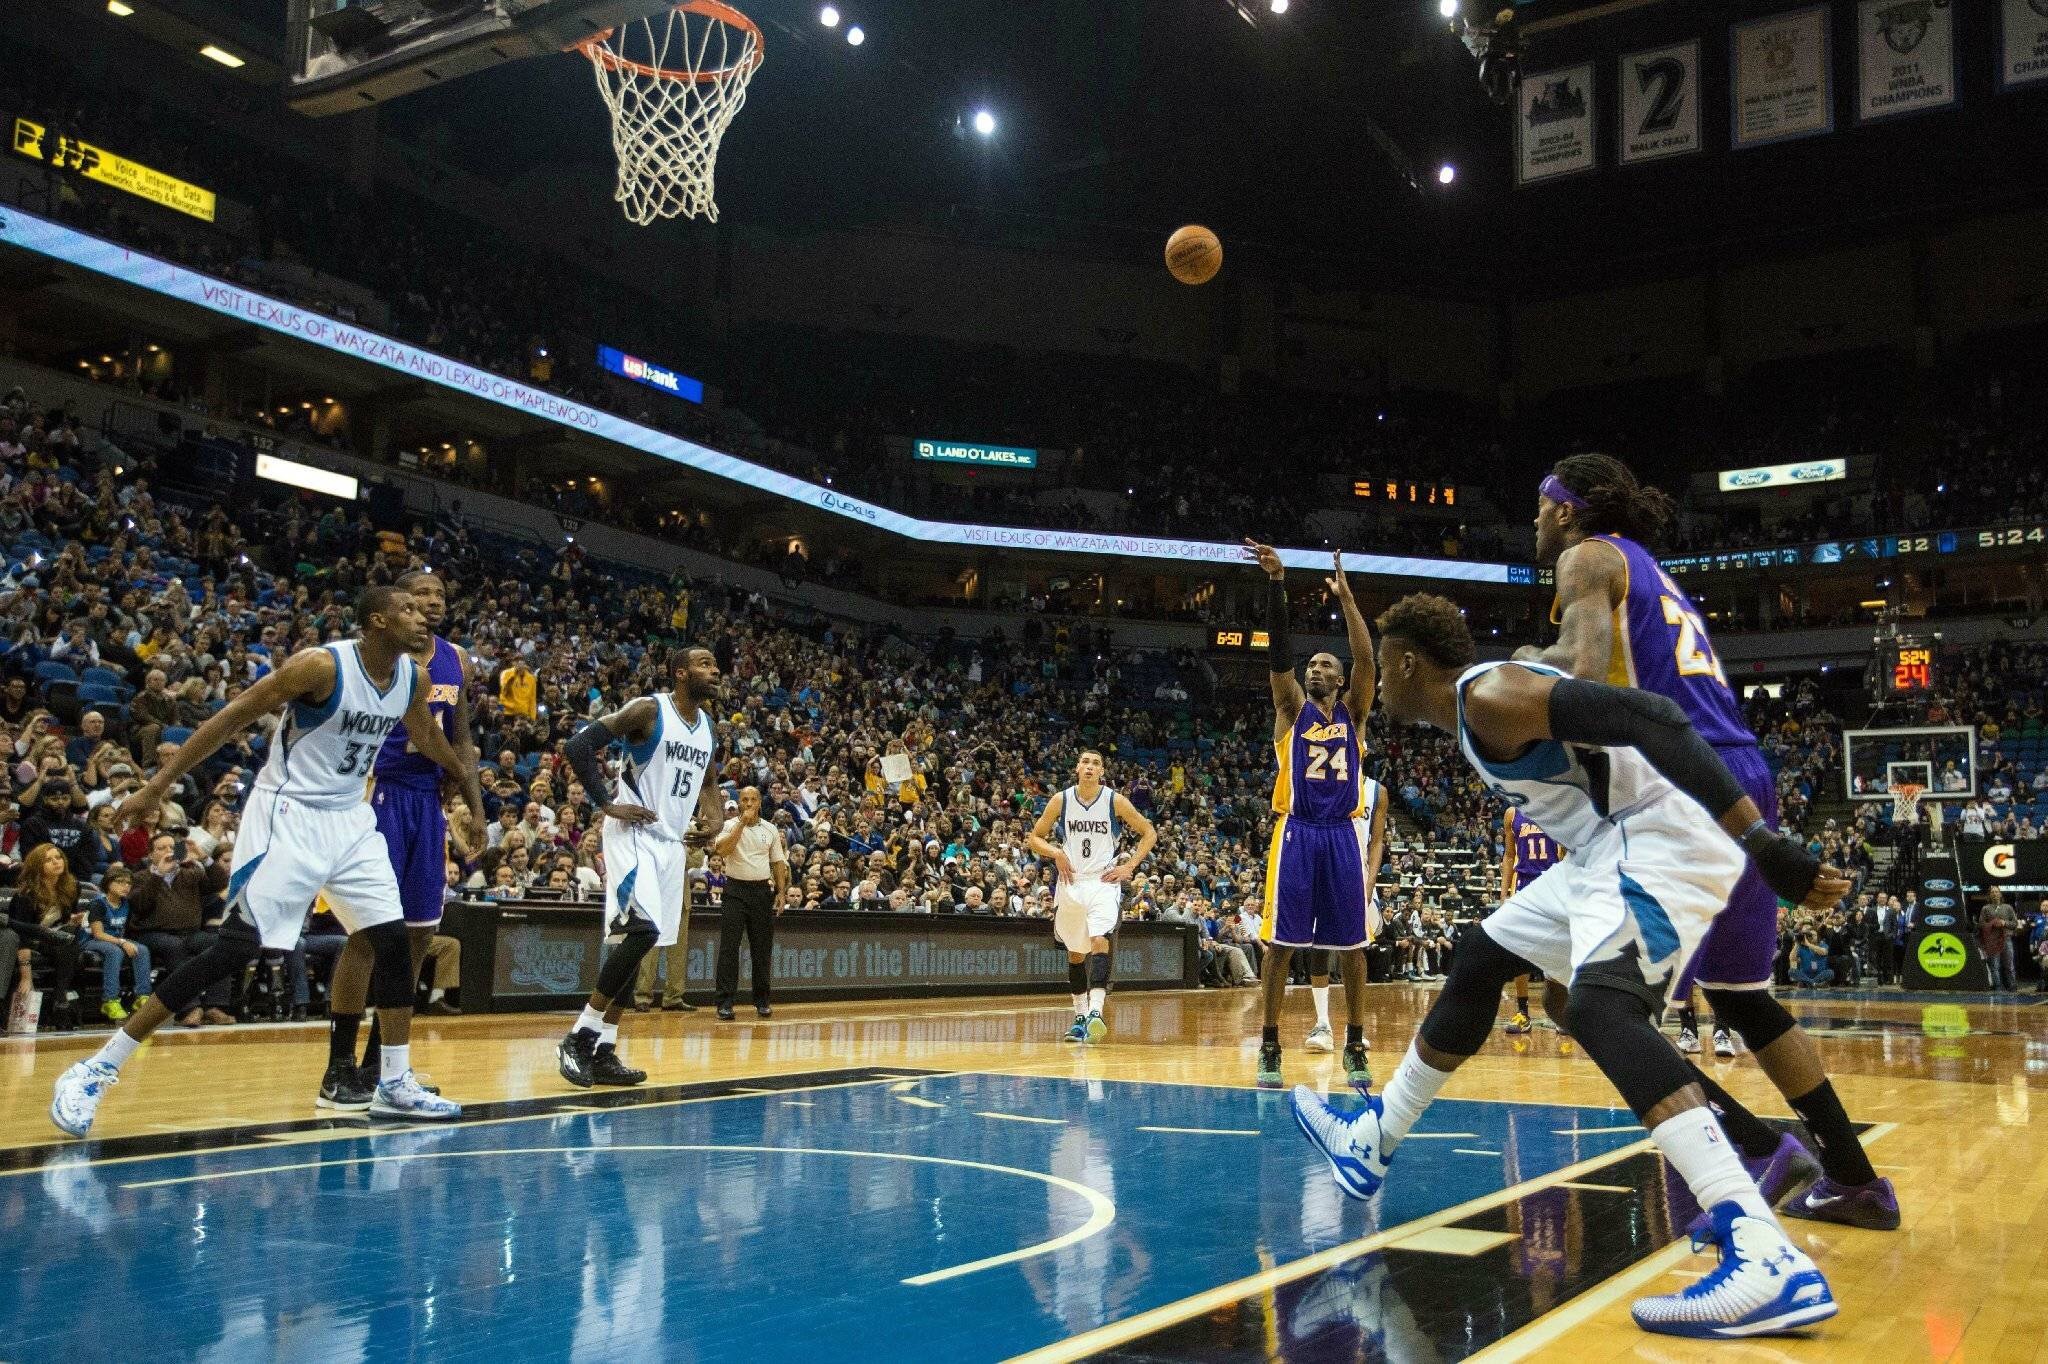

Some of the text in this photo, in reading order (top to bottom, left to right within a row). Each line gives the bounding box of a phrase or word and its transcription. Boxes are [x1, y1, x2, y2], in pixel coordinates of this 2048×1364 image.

[1891, 62, 1920, 77] 2011
[1888, 75, 1925, 90] WNBA
[1634, 57, 1686, 135] 2
[1870, 84, 1943, 107] CHAMPIONS
[1630, 139, 1660, 153] MALIK
[114, 159, 202, 203] Voice Internet Data
[202, 282, 600, 430] VISIT LEXUS OF WAYZATA AND LEXUS OF MAPLEWOOD
[936, 446, 967, 458] LAND
[836, 499, 876, 520] LEXUS
[963, 528, 991, 542] VISIT
[994, 531, 1032, 546] LEXUS
[1034, 533, 1052, 547] OF
[1055, 535, 1111, 551] WAYZATA
[1112, 540, 1139, 552] AND
[1141, 541, 1177, 556] LEXUS
[1180, 544, 1197, 557] OF
[1897, 538, 1930, 553] 32
[1978, 528, 2045, 548] 5:24
[1759, 557, 1769, 566] 3
[1784, 554, 1795, 564] 4
[1510, 567, 1530, 575] CHI
[1510, 576, 1531, 584] MIA
[1216, 631, 1243, 646] 6:50
[1899, 650, 1931, 665] 5:24
[1895, 665, 1929, 689] 24
[664, 740, 709, 769] WOLVES
[1305, 744, 1349, 781] 24
[670, 767, 695, 799] 15
[1066, 819, 1108, 836] WOLVES
[1082, 838, 1092, 859] 8
[1527, 837, 1548, 860] 11
[1983, 843, 2016, 878] G
[832, 941, 859, 978] of
[863, 943, 902, 977] the
[908, 942, 1018, 977] Minnesota
